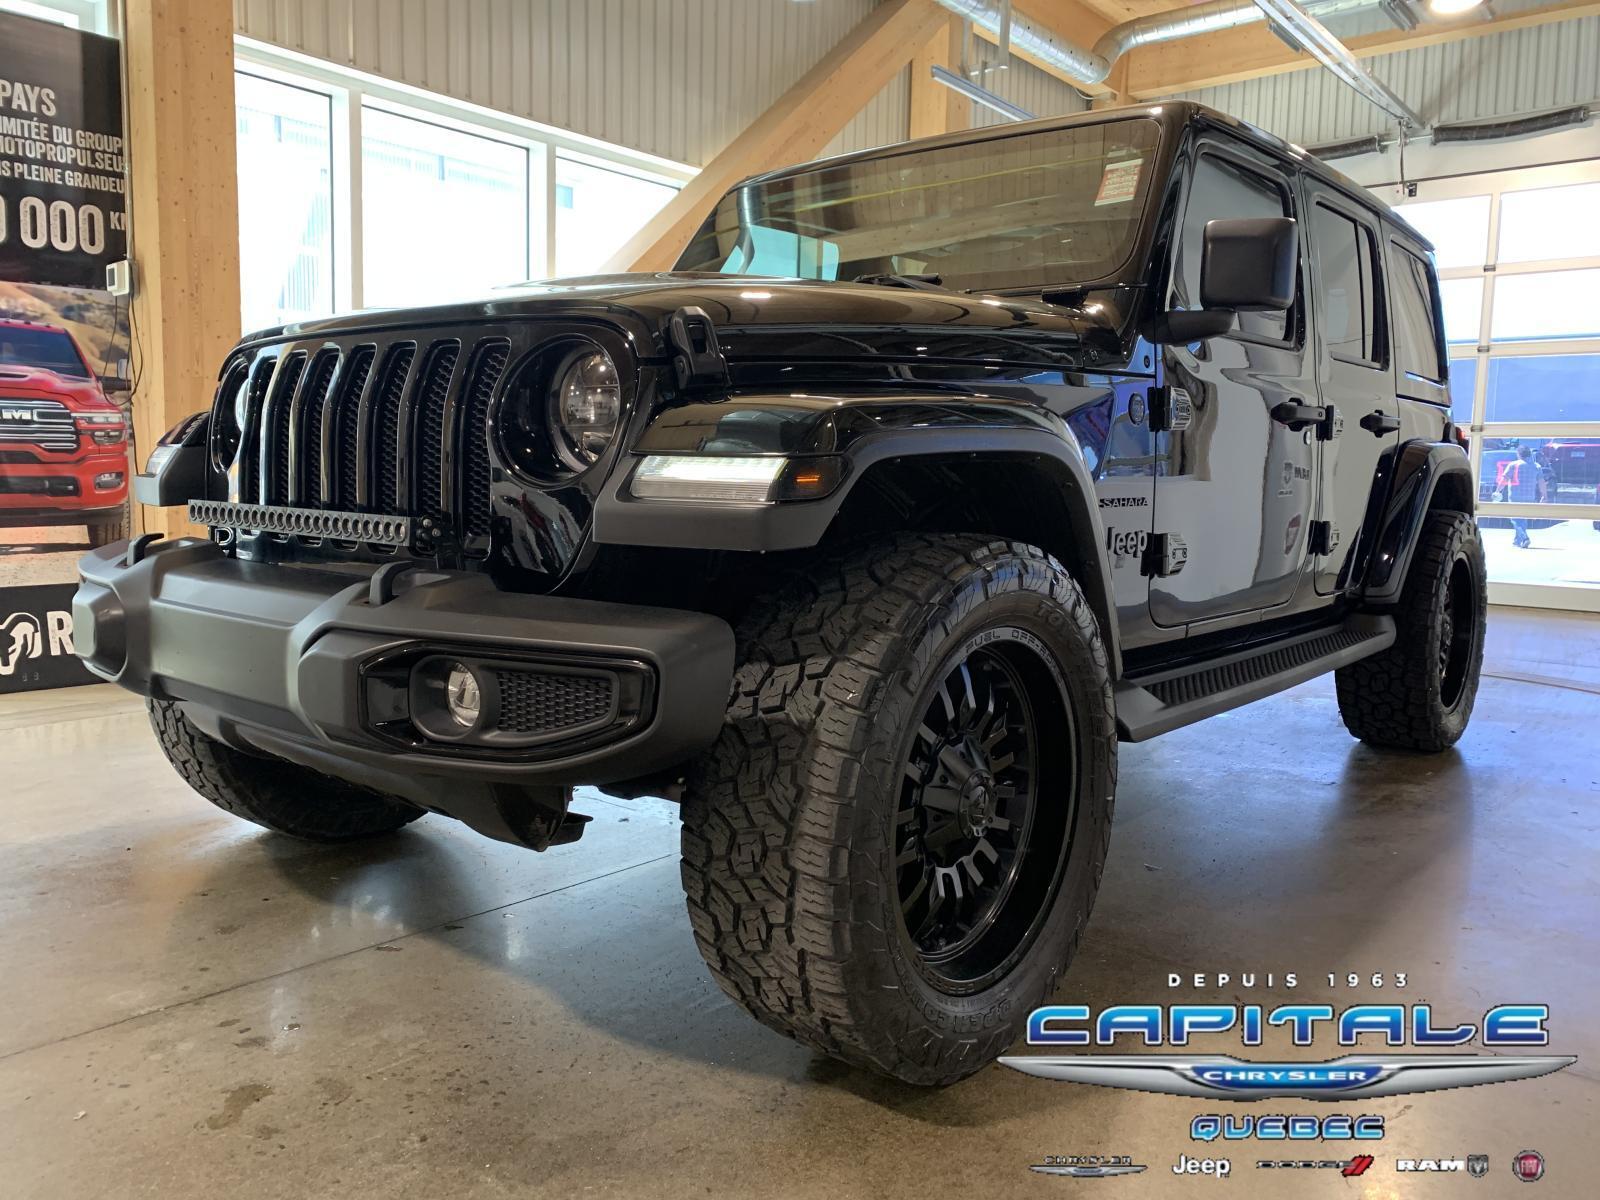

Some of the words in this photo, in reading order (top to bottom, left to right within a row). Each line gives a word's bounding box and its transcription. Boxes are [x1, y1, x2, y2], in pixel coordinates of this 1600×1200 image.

[0, 79, 57, 117] PAYS
[0, 135, 124, 174] OTOPROPULSEU
[52, 124, 73, 145] DU
[76, 129, 122, 154] GROUP
[14, 161, 63, 184] PLEINE
[65, 170, 125, 194] GRANDEU
[1099, 496, 1148, 508] SAHARA
[1106, 526, 1148, 558] Jeep
[46, 611, 75, 657] R
[966, 629, 1001, 653] FUEL
